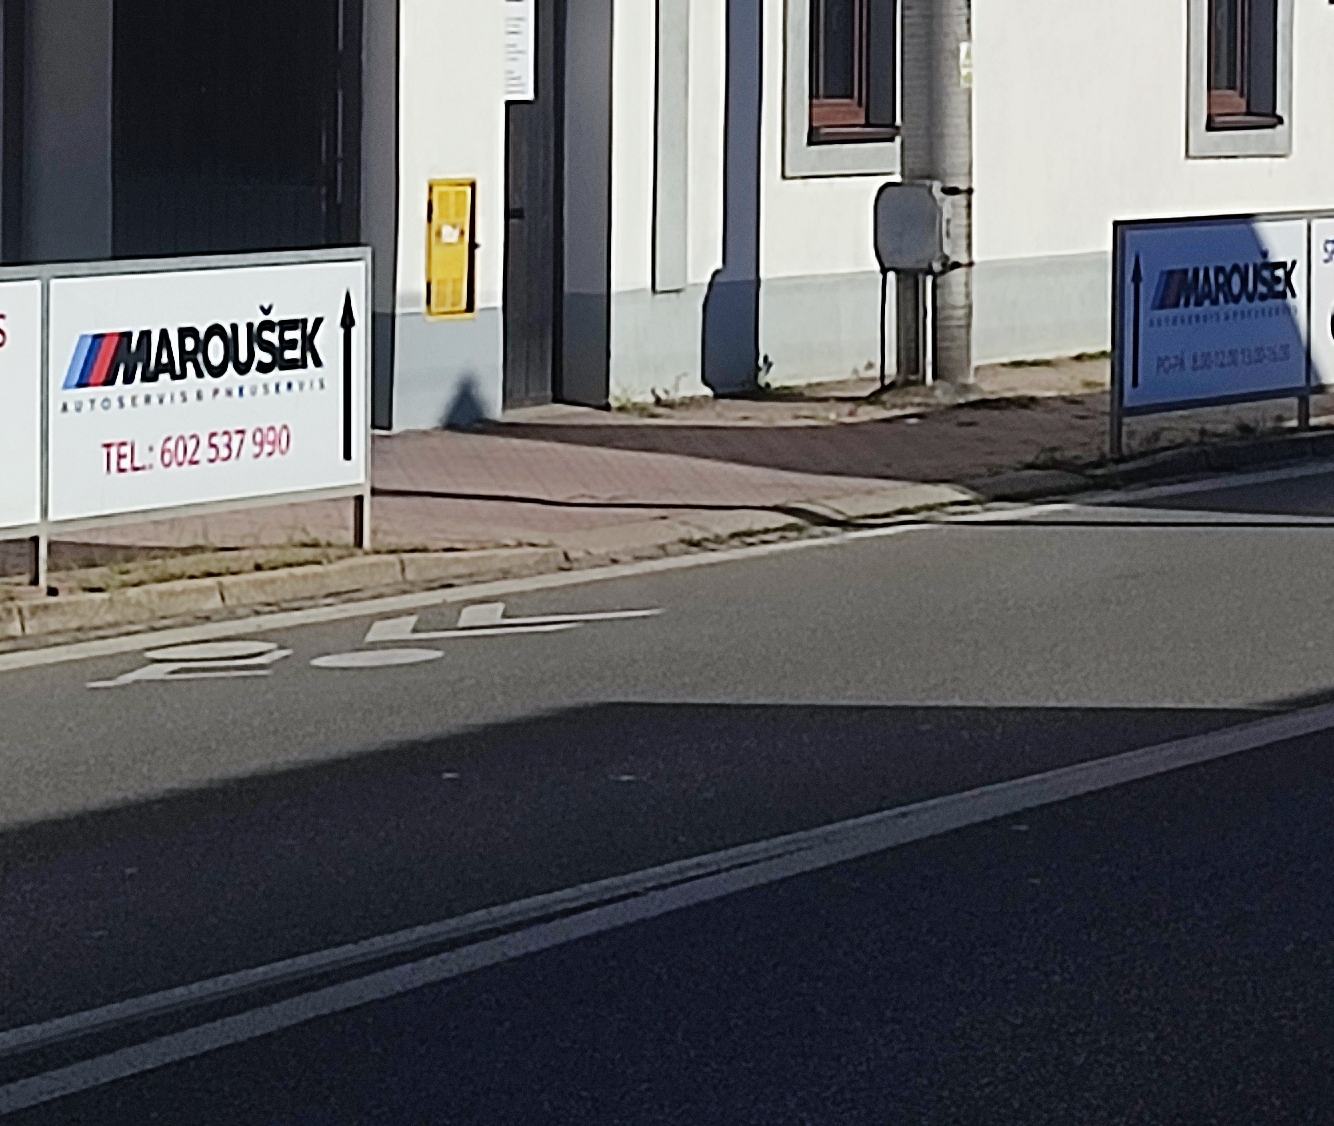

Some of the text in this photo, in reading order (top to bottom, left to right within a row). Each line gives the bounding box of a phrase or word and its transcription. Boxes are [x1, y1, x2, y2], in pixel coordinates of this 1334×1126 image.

[1178, 248, 1298, 309] MAROUŠEK
[109, 303, 324, 386] MAROUŠEK
[60, 390, 189, 414] AUTOSERVIS
[212, 378, 326, 399] PNEUSERVIS
[101, 424, 292, 475] TEL.: 602 537 990
